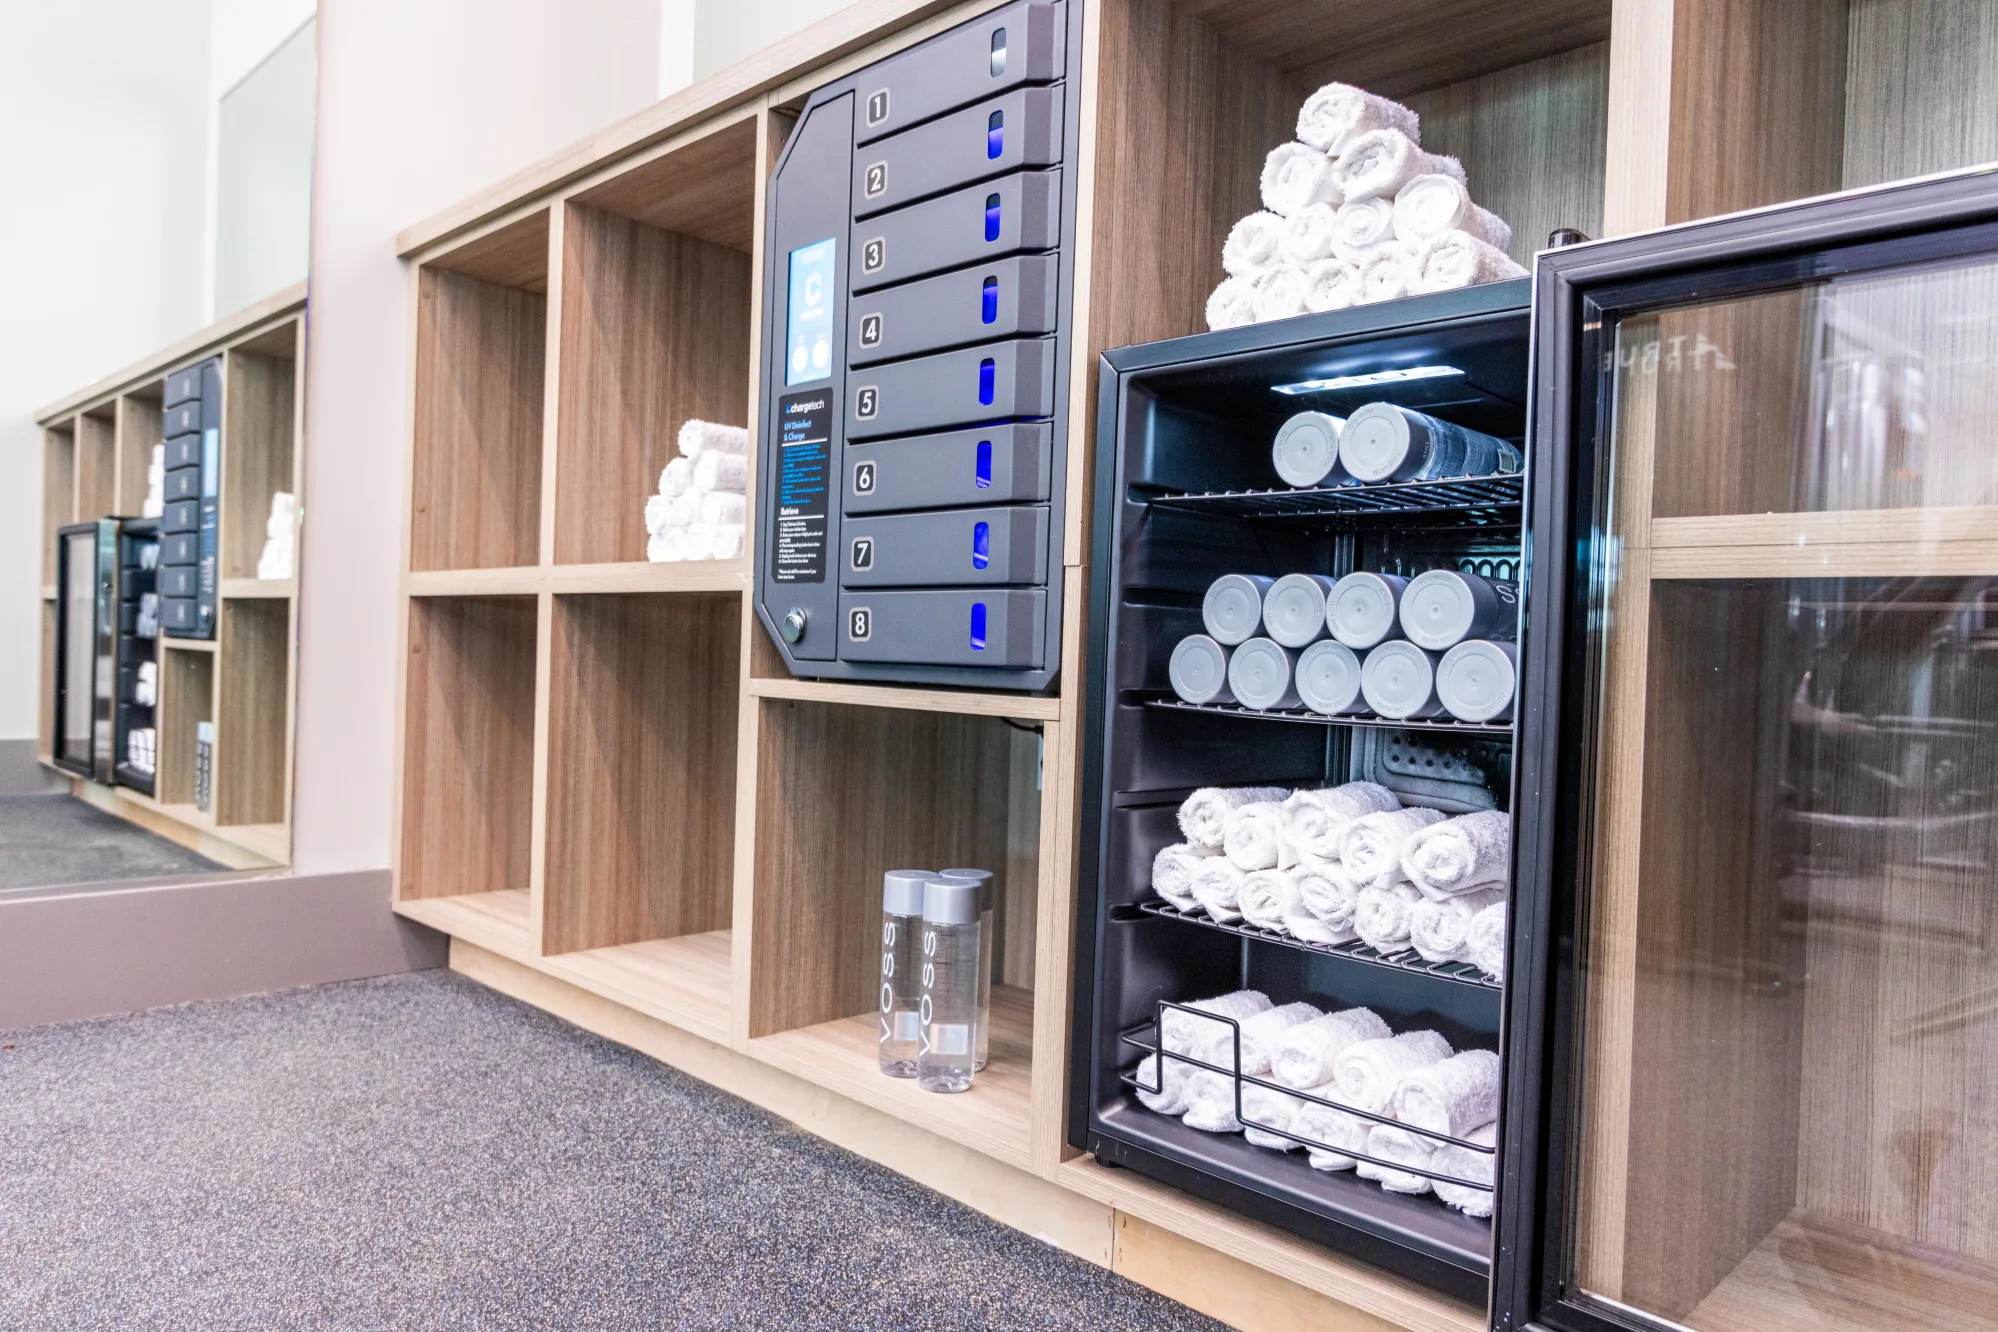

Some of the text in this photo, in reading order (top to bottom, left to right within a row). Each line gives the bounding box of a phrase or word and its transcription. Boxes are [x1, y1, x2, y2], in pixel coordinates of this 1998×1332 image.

[873, 96, 881, 118] 1
[870, 168, 882, 192] 2
[868, 244, 879, 267] 3
[865, 319, 877, 341] 4
[791, 399, 825, 413] chargetech
[861, 391, 872, 414] 5
[788, 432, 805, 442] Charge
[858, 467, 870, 489] 6
[780, 507, 800, 516] Retrieve
[857, 542, 869, 565] 7
[855, 613, 866, 635] 8
[880, 922, 896, 1044] VOSS
[919, 931, 937, 1057] VOSS
